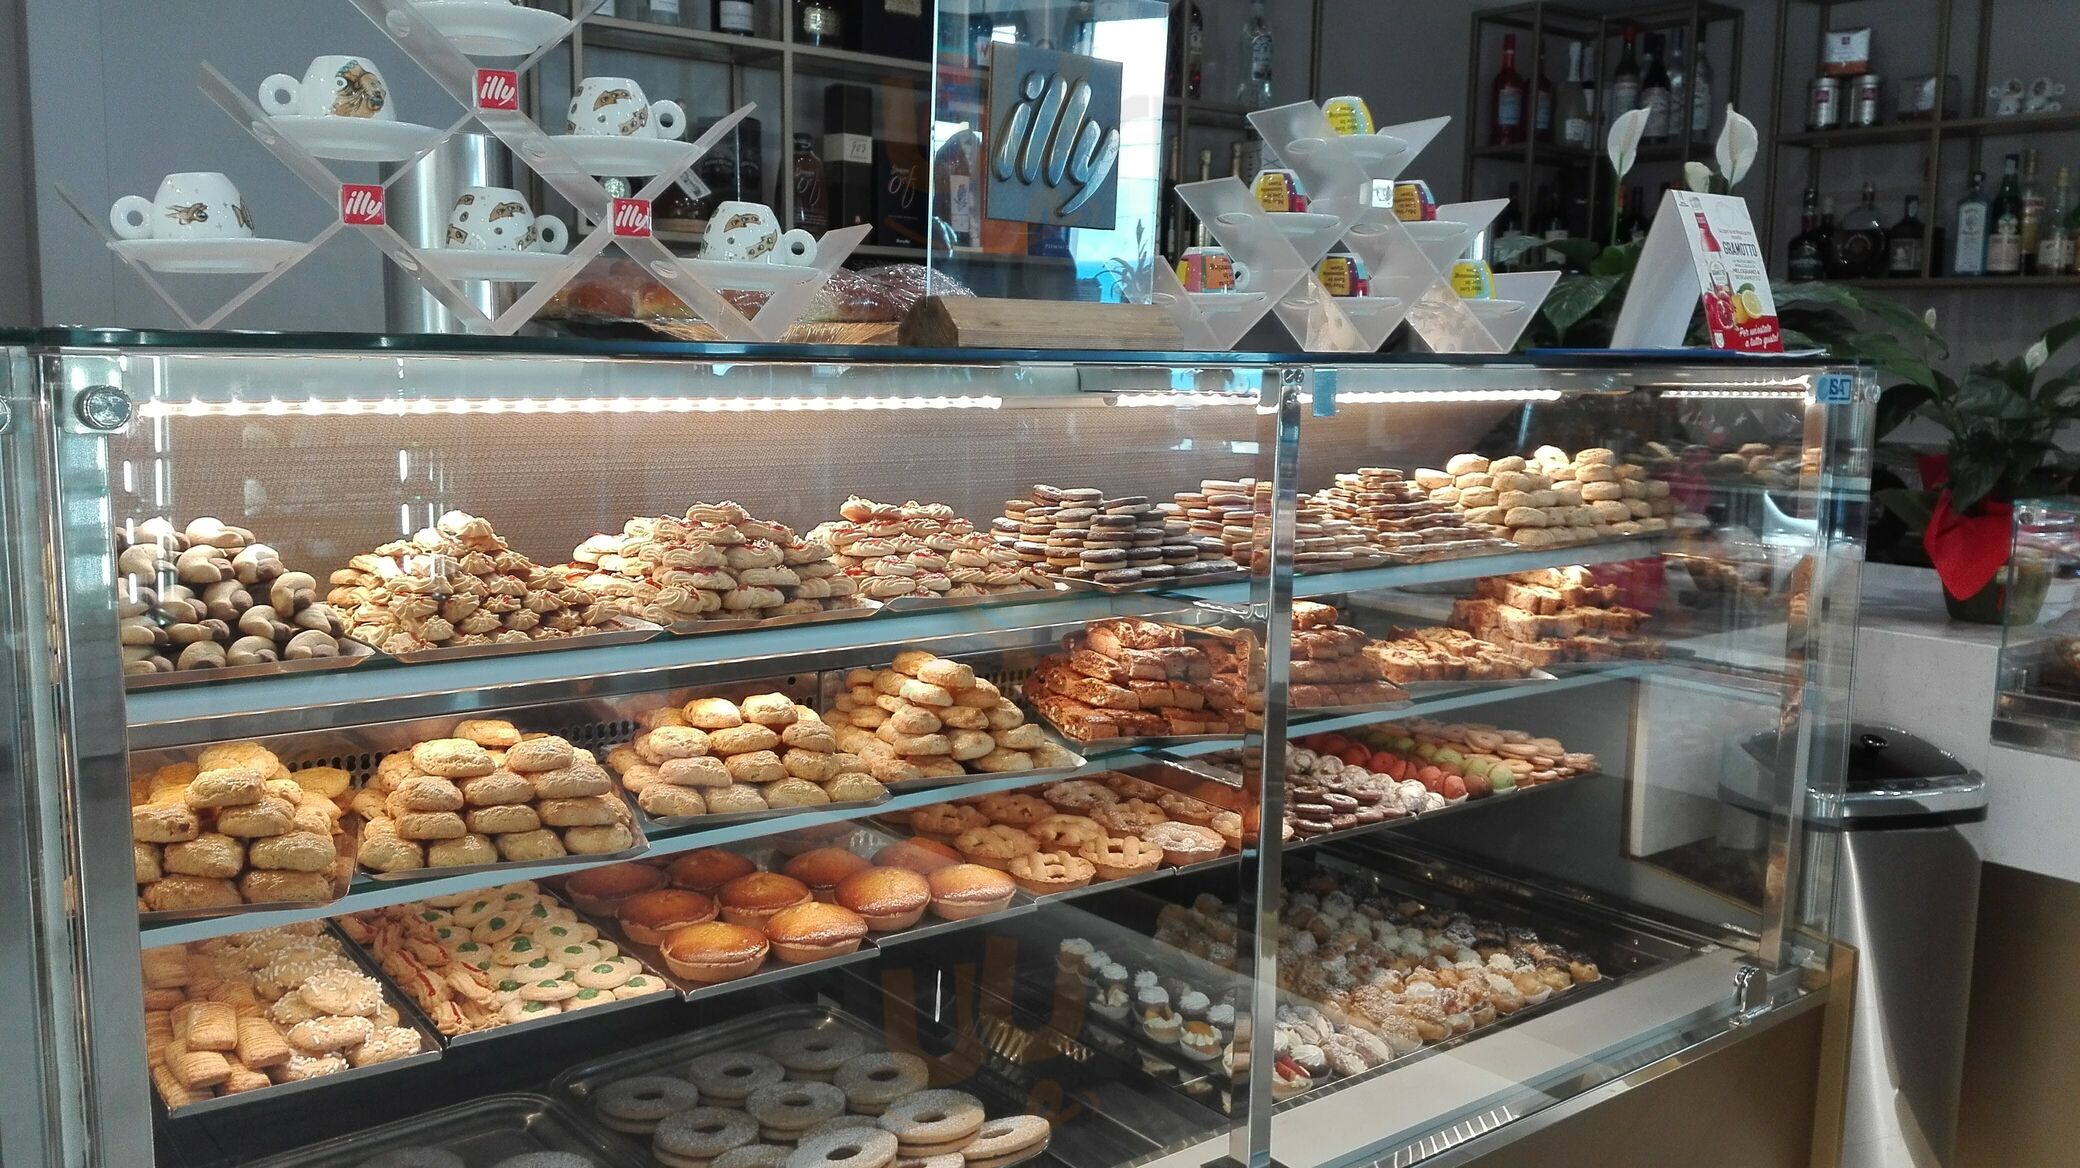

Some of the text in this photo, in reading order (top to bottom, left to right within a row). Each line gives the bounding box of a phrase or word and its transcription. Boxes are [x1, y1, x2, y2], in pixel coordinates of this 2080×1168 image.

[481, 75, 515, 106] illy
[997, 71, 1120, 218] illy
[345, 190, 382, 220] illy
[616, 205, 651, 233] illy
[1722, 241, 1758, 257] GRAMOTTO
[1829, 378, 1845, 395] ISA
